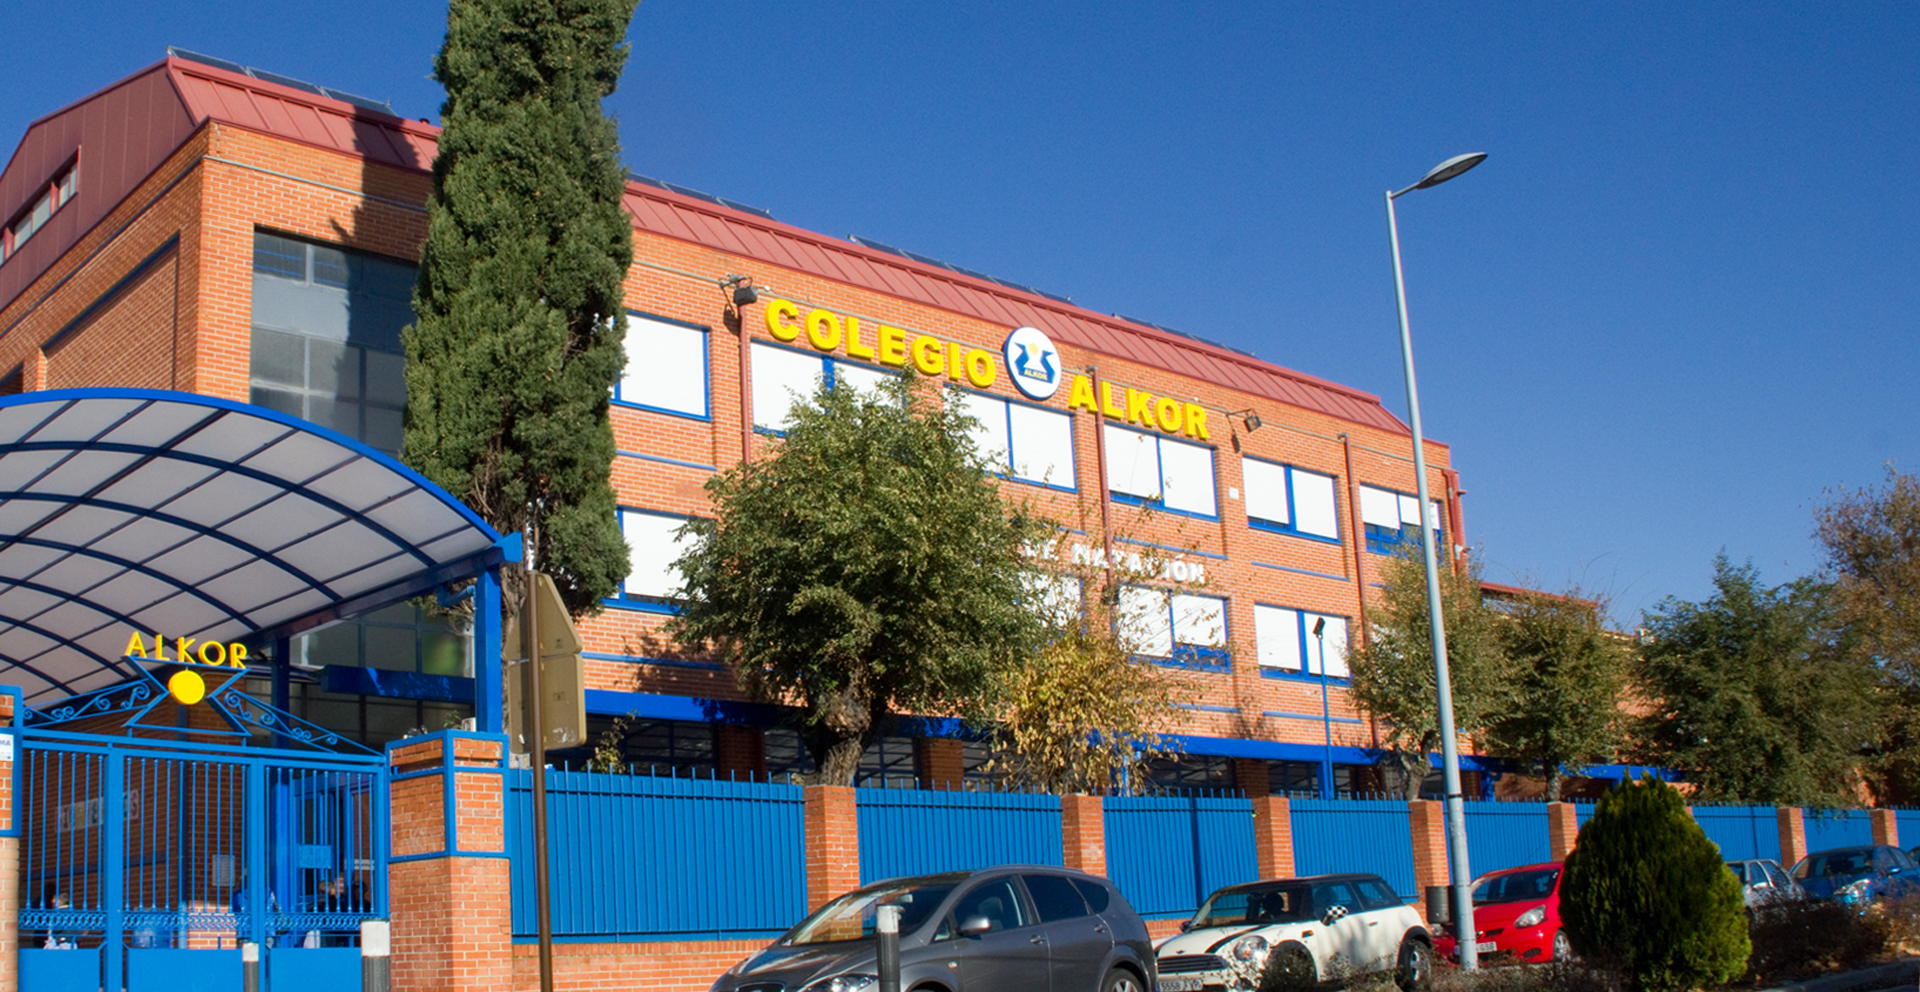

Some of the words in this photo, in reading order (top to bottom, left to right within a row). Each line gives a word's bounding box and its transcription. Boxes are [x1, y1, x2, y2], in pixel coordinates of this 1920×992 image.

[764, 299, 997, 388] COLEGIO
[1067, 374, 1210, 440] ALKOR
[1024, 368, 1048, 381] ALKOR
[124, 631, 248, 669] ALKOR
